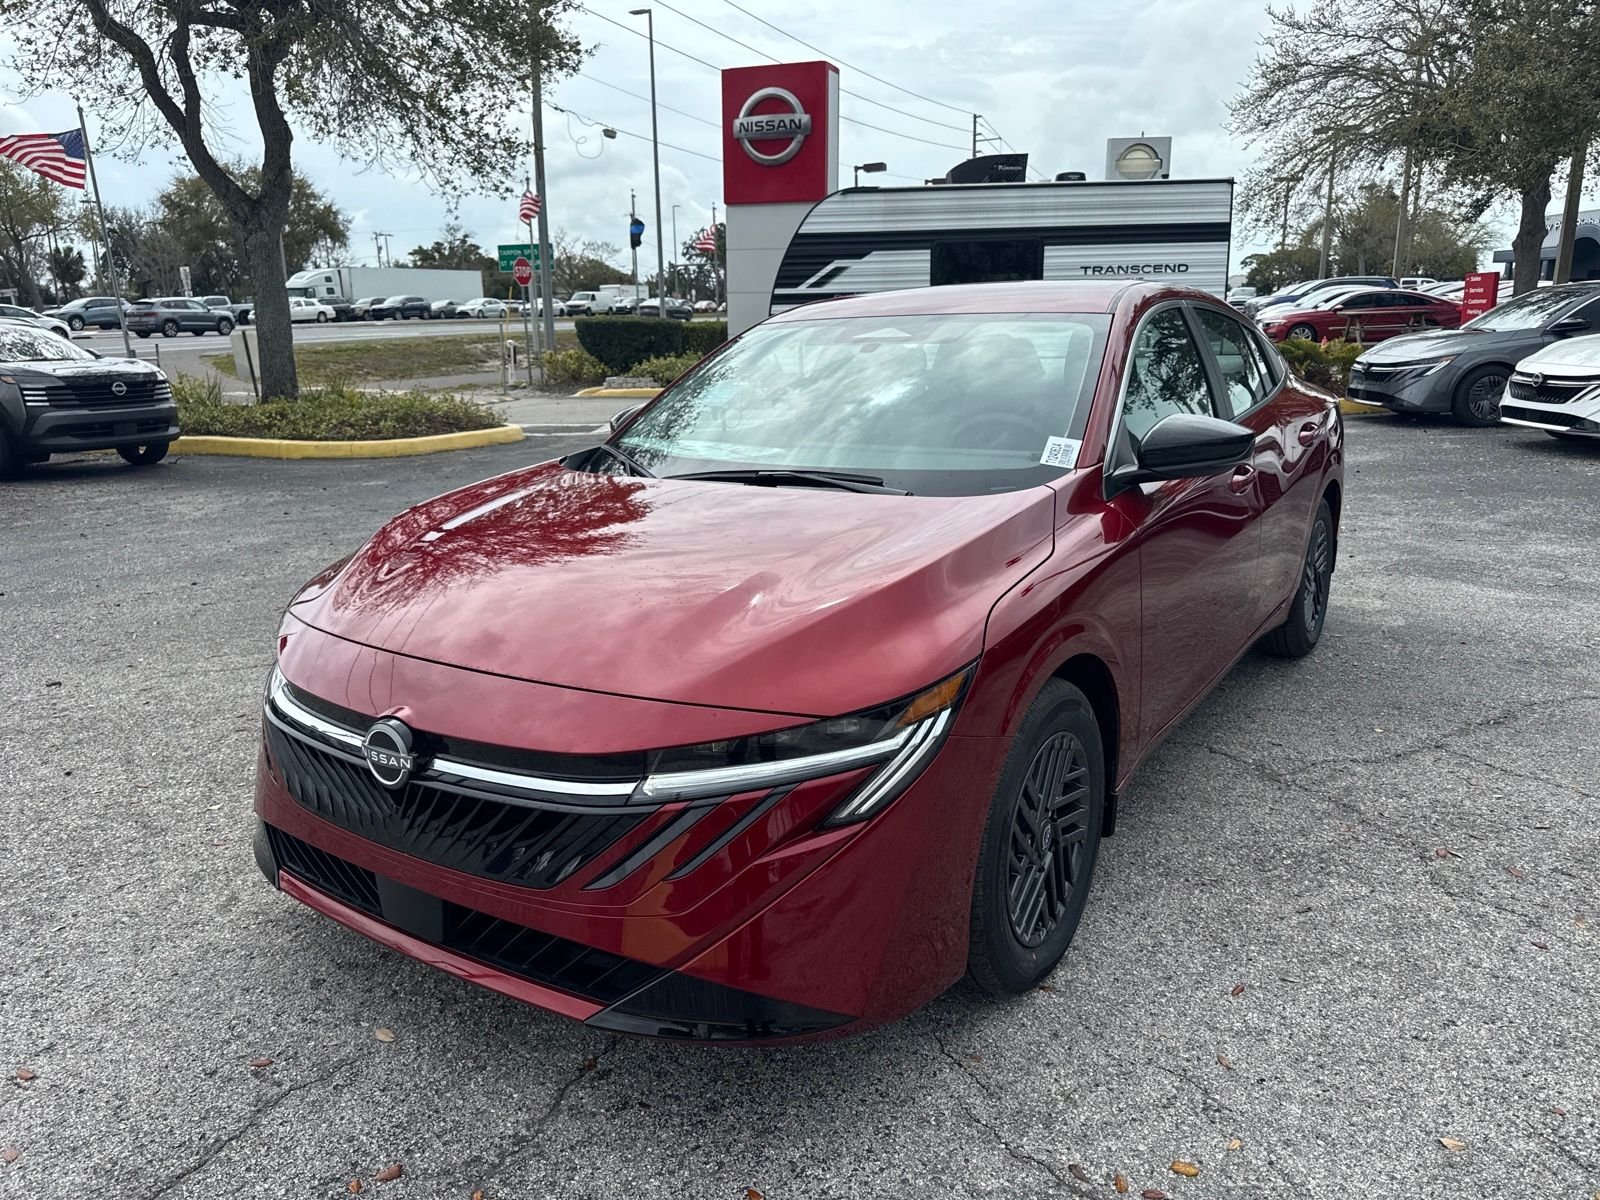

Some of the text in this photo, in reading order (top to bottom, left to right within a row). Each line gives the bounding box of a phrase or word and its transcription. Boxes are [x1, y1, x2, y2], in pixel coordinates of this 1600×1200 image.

[738, 118, 802, 134] NISSAN
[515, 265, 531, 277] STOP
[1080, 263, 1189, 275] TRANSCEND
[361, 744, 411, 769] NISSAN
